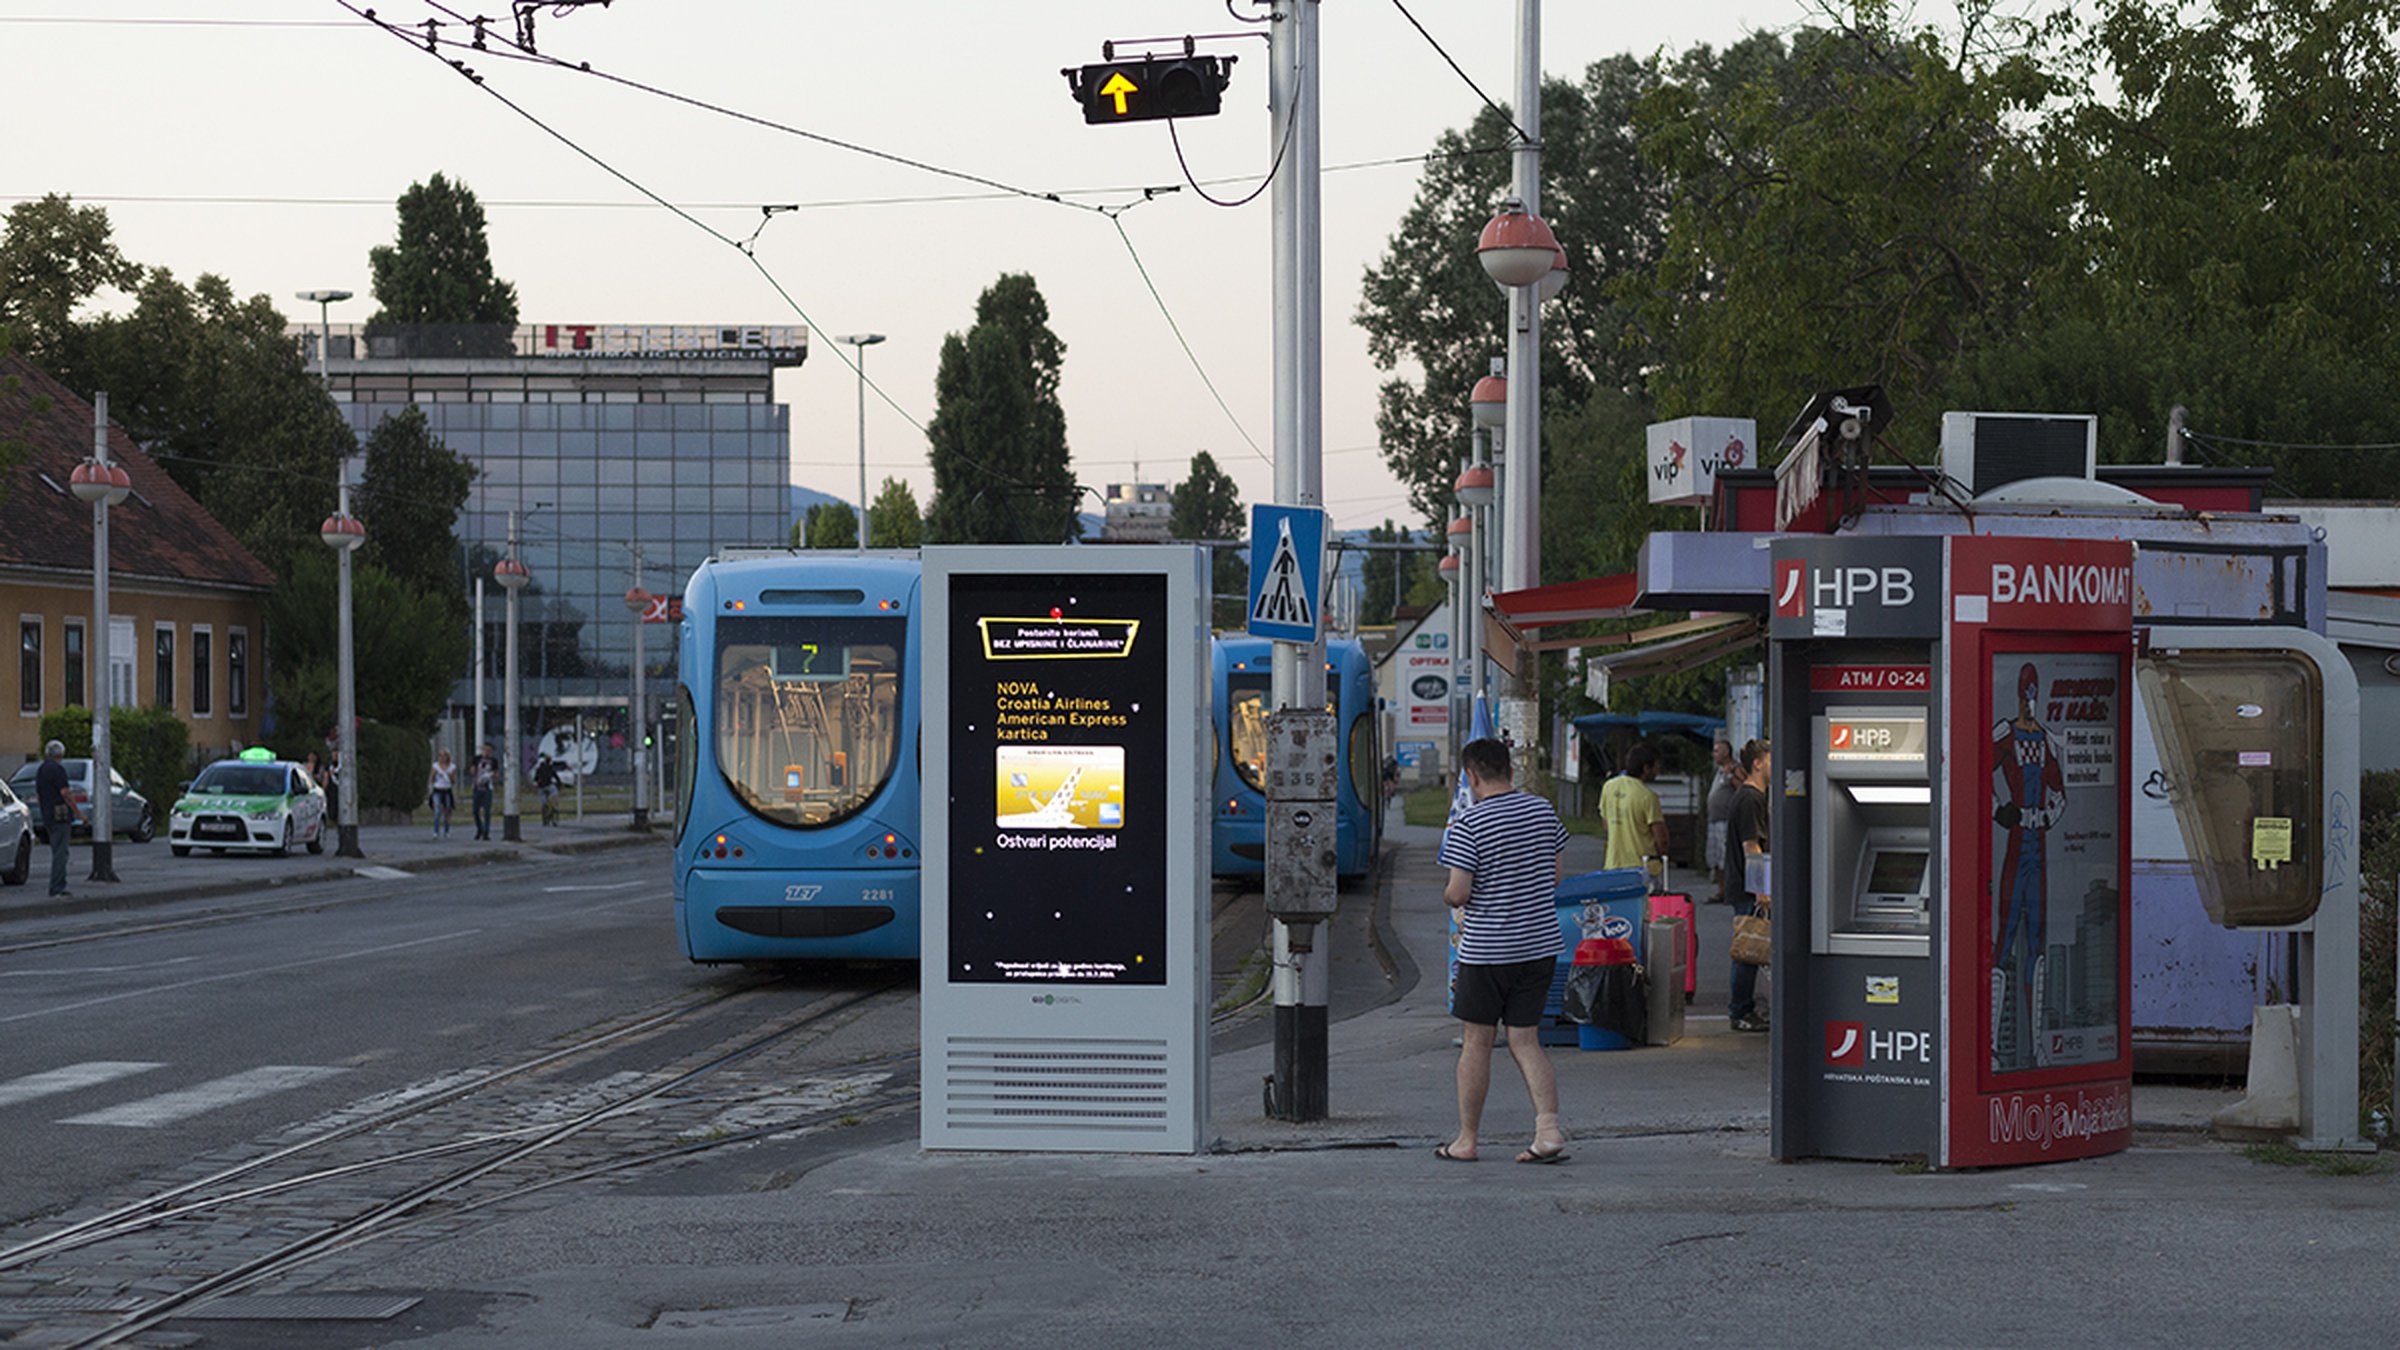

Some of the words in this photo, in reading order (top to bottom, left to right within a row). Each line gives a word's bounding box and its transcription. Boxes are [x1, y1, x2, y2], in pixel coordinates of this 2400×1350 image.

[545, 325, 596, 349] IT
[1654, 457, 1679, 484] vip
[1813, 567, 1915, 607] HPB
[1991, 563, 2130, 605] BANKOMAT
[993, 639, 1011, 648] BEZ
[1409, 657, 1449, 667] OPTIKA
[1840, 671, 1874, 686] ATM
[1887, 671, 1926, 686] 0-24
[997, 682, 1039, 695] NOVA
[997, 697, 1051, 710] Croatia
[1054, 697, 1110, 710] Airlines
[997, 713, 1066, 725] American
[1069, 713, 1127, 728] Express
[997, 728, 1049, 740] kartica
[1853, 728, 1892, 747] HPB
[997, 834, 1047, 848] Ostvari
[1049, 835, 1117, 851] potencijal
[862, 889, 894, 900] 2281
[1990, 1093, 2069, 1150] Moja
